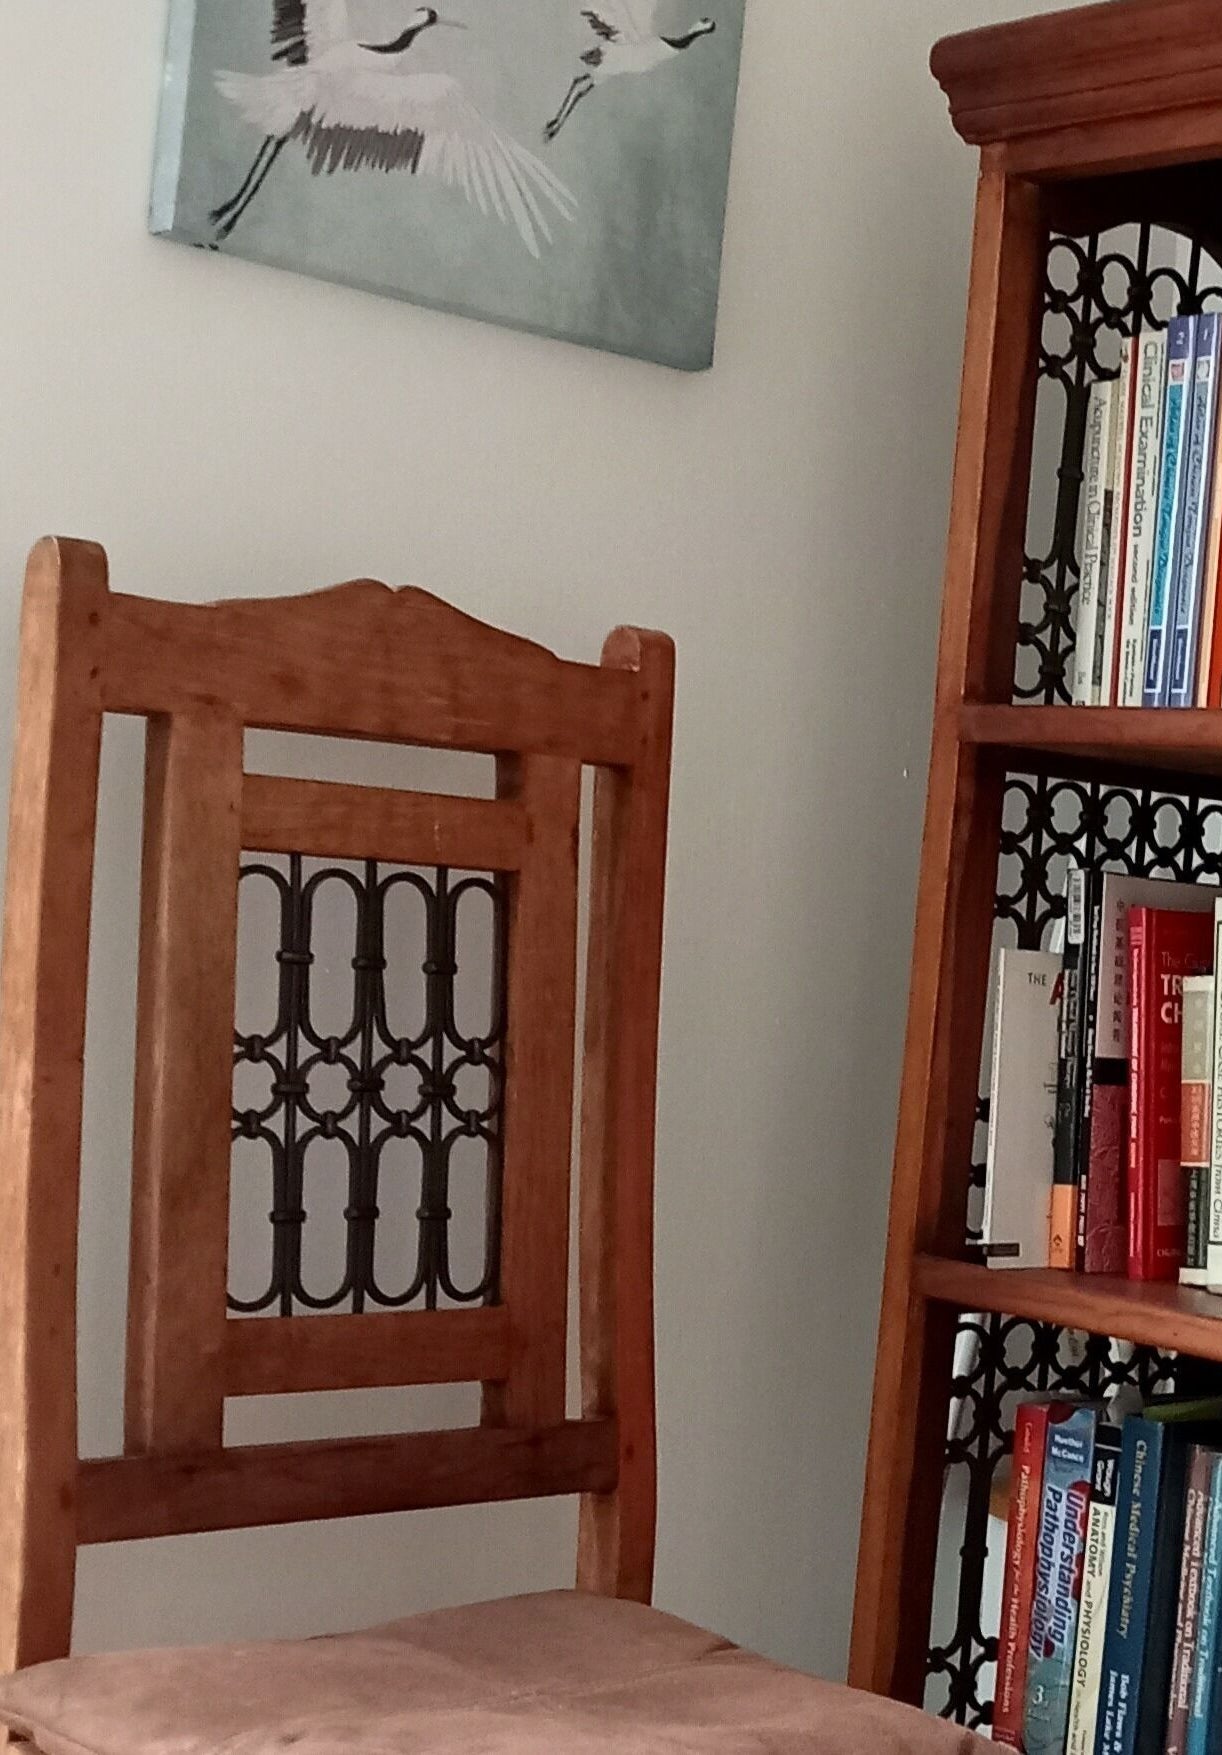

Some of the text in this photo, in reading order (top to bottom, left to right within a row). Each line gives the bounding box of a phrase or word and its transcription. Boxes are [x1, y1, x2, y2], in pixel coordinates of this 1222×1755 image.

[1139, 342, 1159, 411] Clinical
[1131, 415, 1154, 537] Examination
[1130, 543, 1140, 584] second
[1127, 586, 1138, 625] edition
[1027, 972, 1048, 987] THE
[1094, 1459, 1107, 1492] Grant
[1102, 1459, 1115, 1498] Waugh
[1117, 1439, 1148, 1638] Chinese Medical Psychiatry
[1189, 1490, 1205, 1558] Advanced
[1002, 1463, 1032, 1713] Pathophysiology for Health Professions
[1029, 1486, 1062, 1659] Pathophysiology
[1049, 1490, 1086, 1645] Understanding
[1076, 1506, 1103, 1688] ANATOMY and PHYSIOLOGY
[1185, 1559, 1202, 1618] Textbook
[1200, 1567, 1219, 1627] Textbook
[1184, 1620, 1194, 1638] on
[1199, 1629, 1209, 1645] on
[1031, 1684, 1045, 1704] 3
[1103, 1670, 1120, 1740] James Lake
[1176, 1640, 1195, 1710] Traditional
[1193, 1648, 1211, 1718] Traditional
[1115, 1673, 1131, 1750] Bob Flaws &
